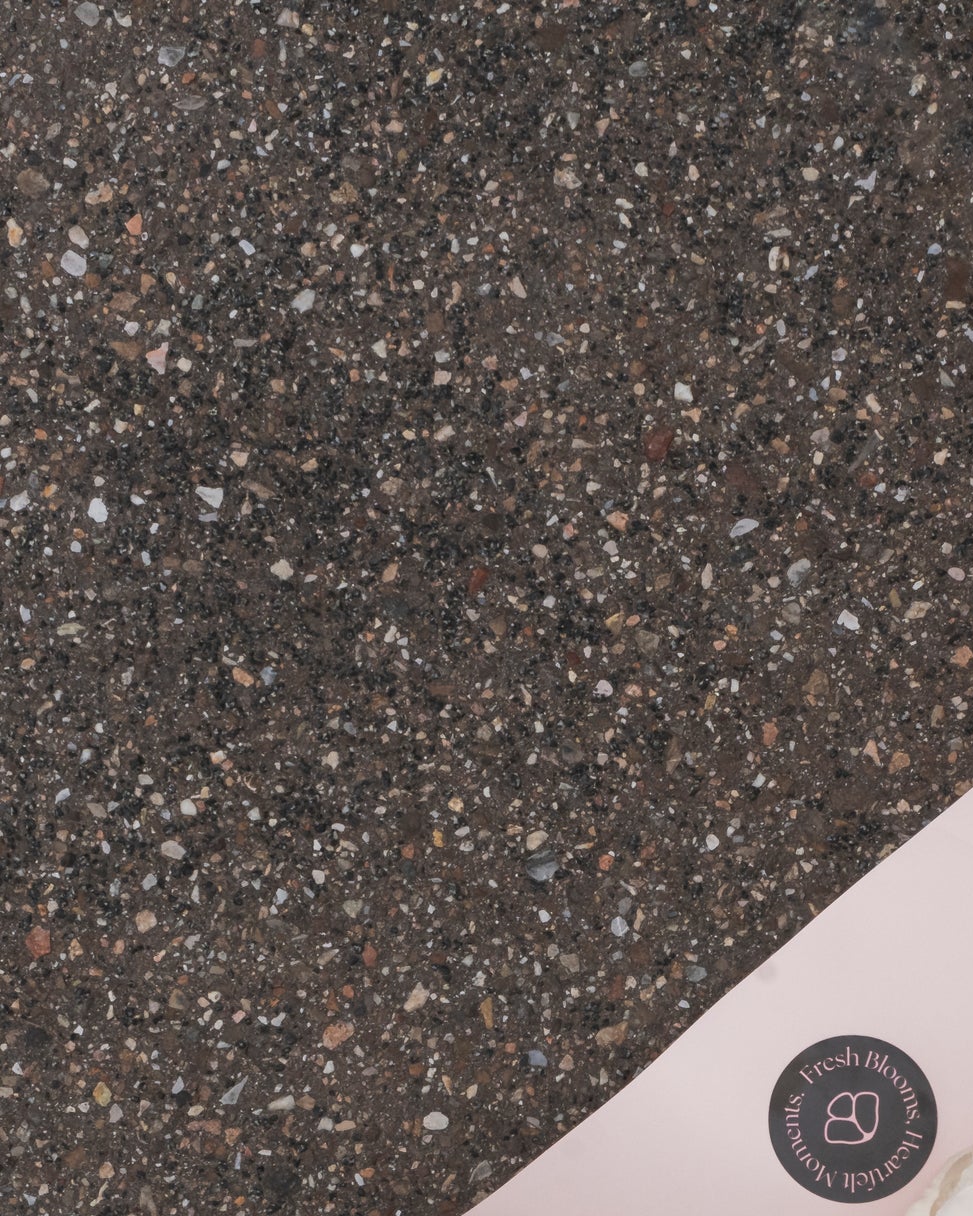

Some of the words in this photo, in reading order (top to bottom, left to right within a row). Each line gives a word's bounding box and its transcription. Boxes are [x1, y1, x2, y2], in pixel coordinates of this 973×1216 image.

[799, 1046, 860, 1084] Fresh
[864, 1050, 921, 1125] Blooms,
[784, 1093, 838, 1188] Moments.
[843, 1130, 923, 1193] Heartfelt
